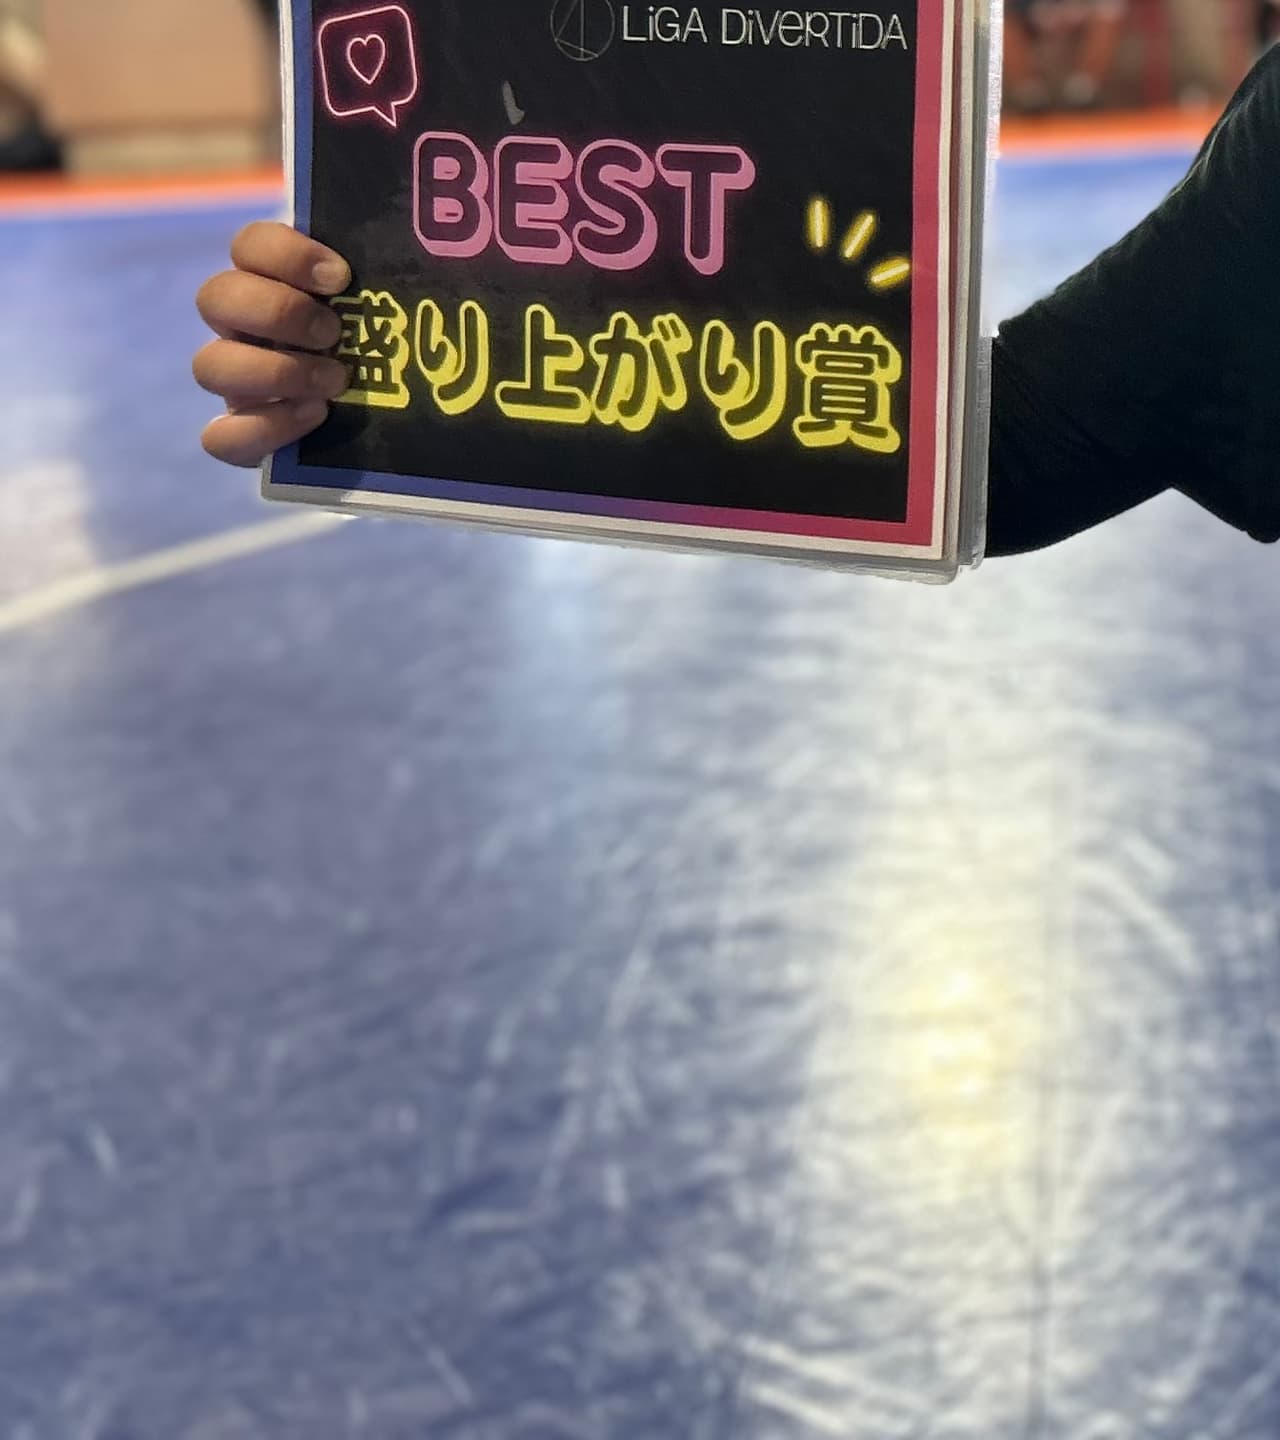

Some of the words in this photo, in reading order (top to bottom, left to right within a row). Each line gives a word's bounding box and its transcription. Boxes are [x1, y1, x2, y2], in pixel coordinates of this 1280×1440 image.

[412, 131, 756, 275] BEST
[332, 290, 902, 452] 盛り上がり賞
